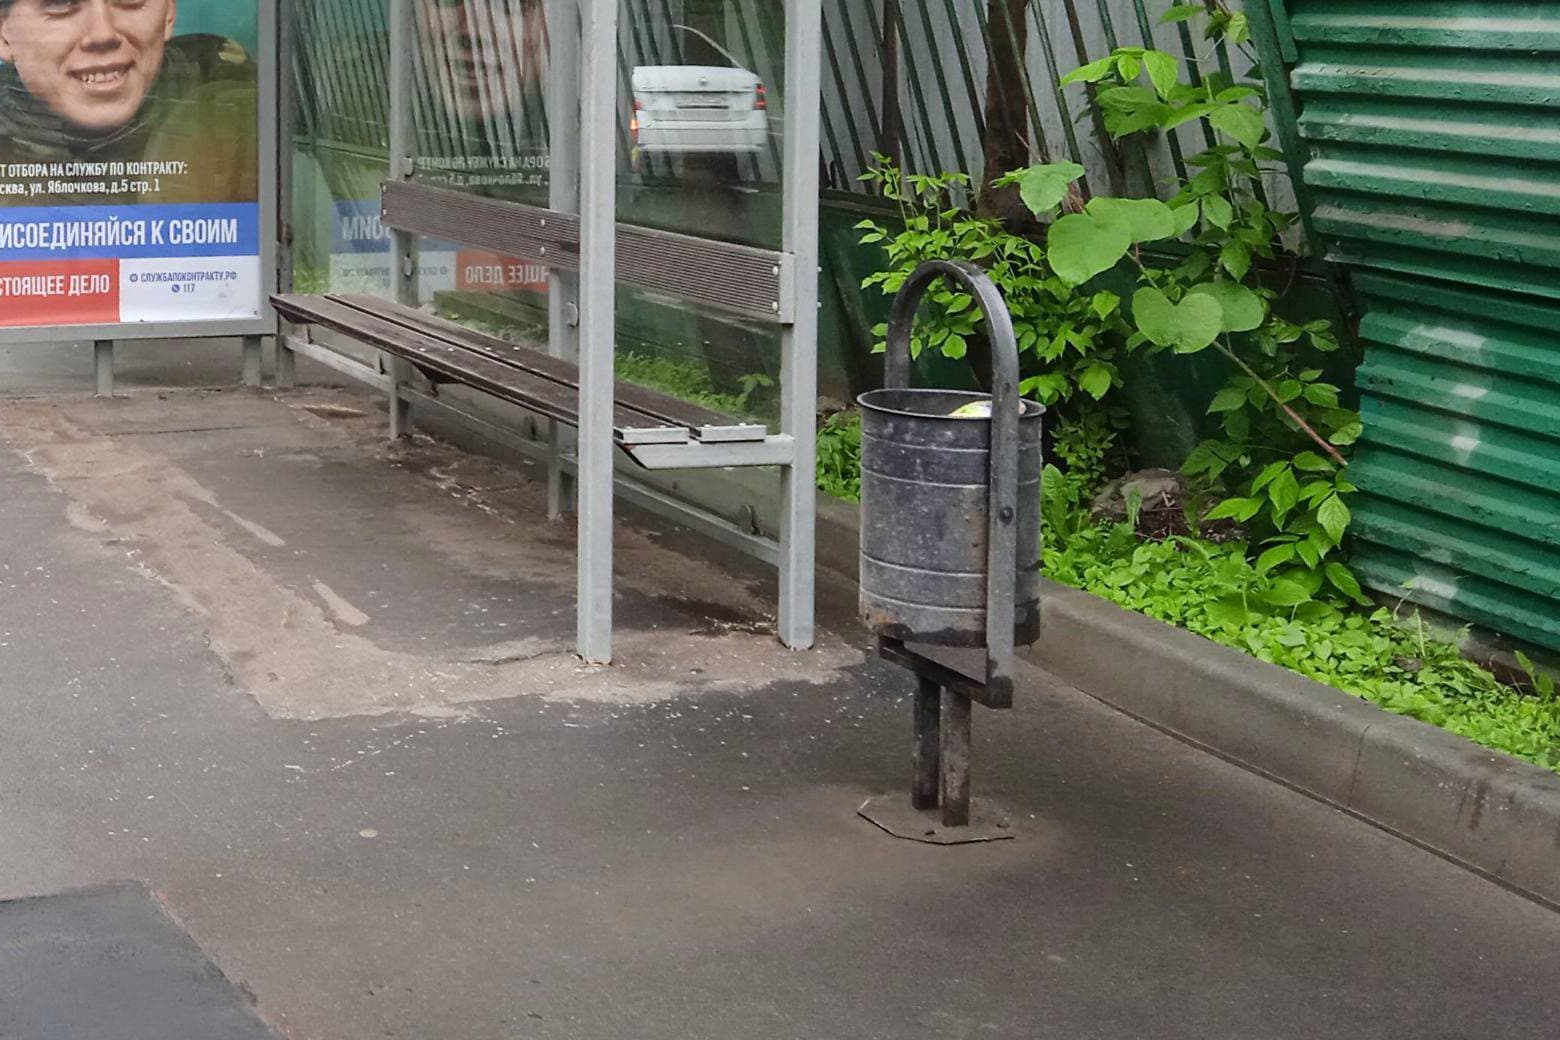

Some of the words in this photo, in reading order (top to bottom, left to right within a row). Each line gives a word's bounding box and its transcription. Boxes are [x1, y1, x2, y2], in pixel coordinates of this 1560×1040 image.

[8, 163, 49, 178] ОТБОРА
[49, 163, 65, 177] НА
[65, 162, 108, 177] СЛУЖБУ
[109, 162, 124, 176] ПО
[126, 161, 188, 176] КОНТРАКТУ:
[29, 182, 45, 197] ул.
[47, 180, 110, 195] Яблочкова,
[130, 181, 152, 194] стр.
[154, 178, 160, 192] 1
[151, 220, 164, 245] К
[169, 218, 238, 245] СВОИМ
[68, 274, 110, 296] ДЕЛО
[140, 271, 237, 282] СЛУЖБАПОКОНТРАКТУ.РФ
[183, 283, 196, 293] 117
